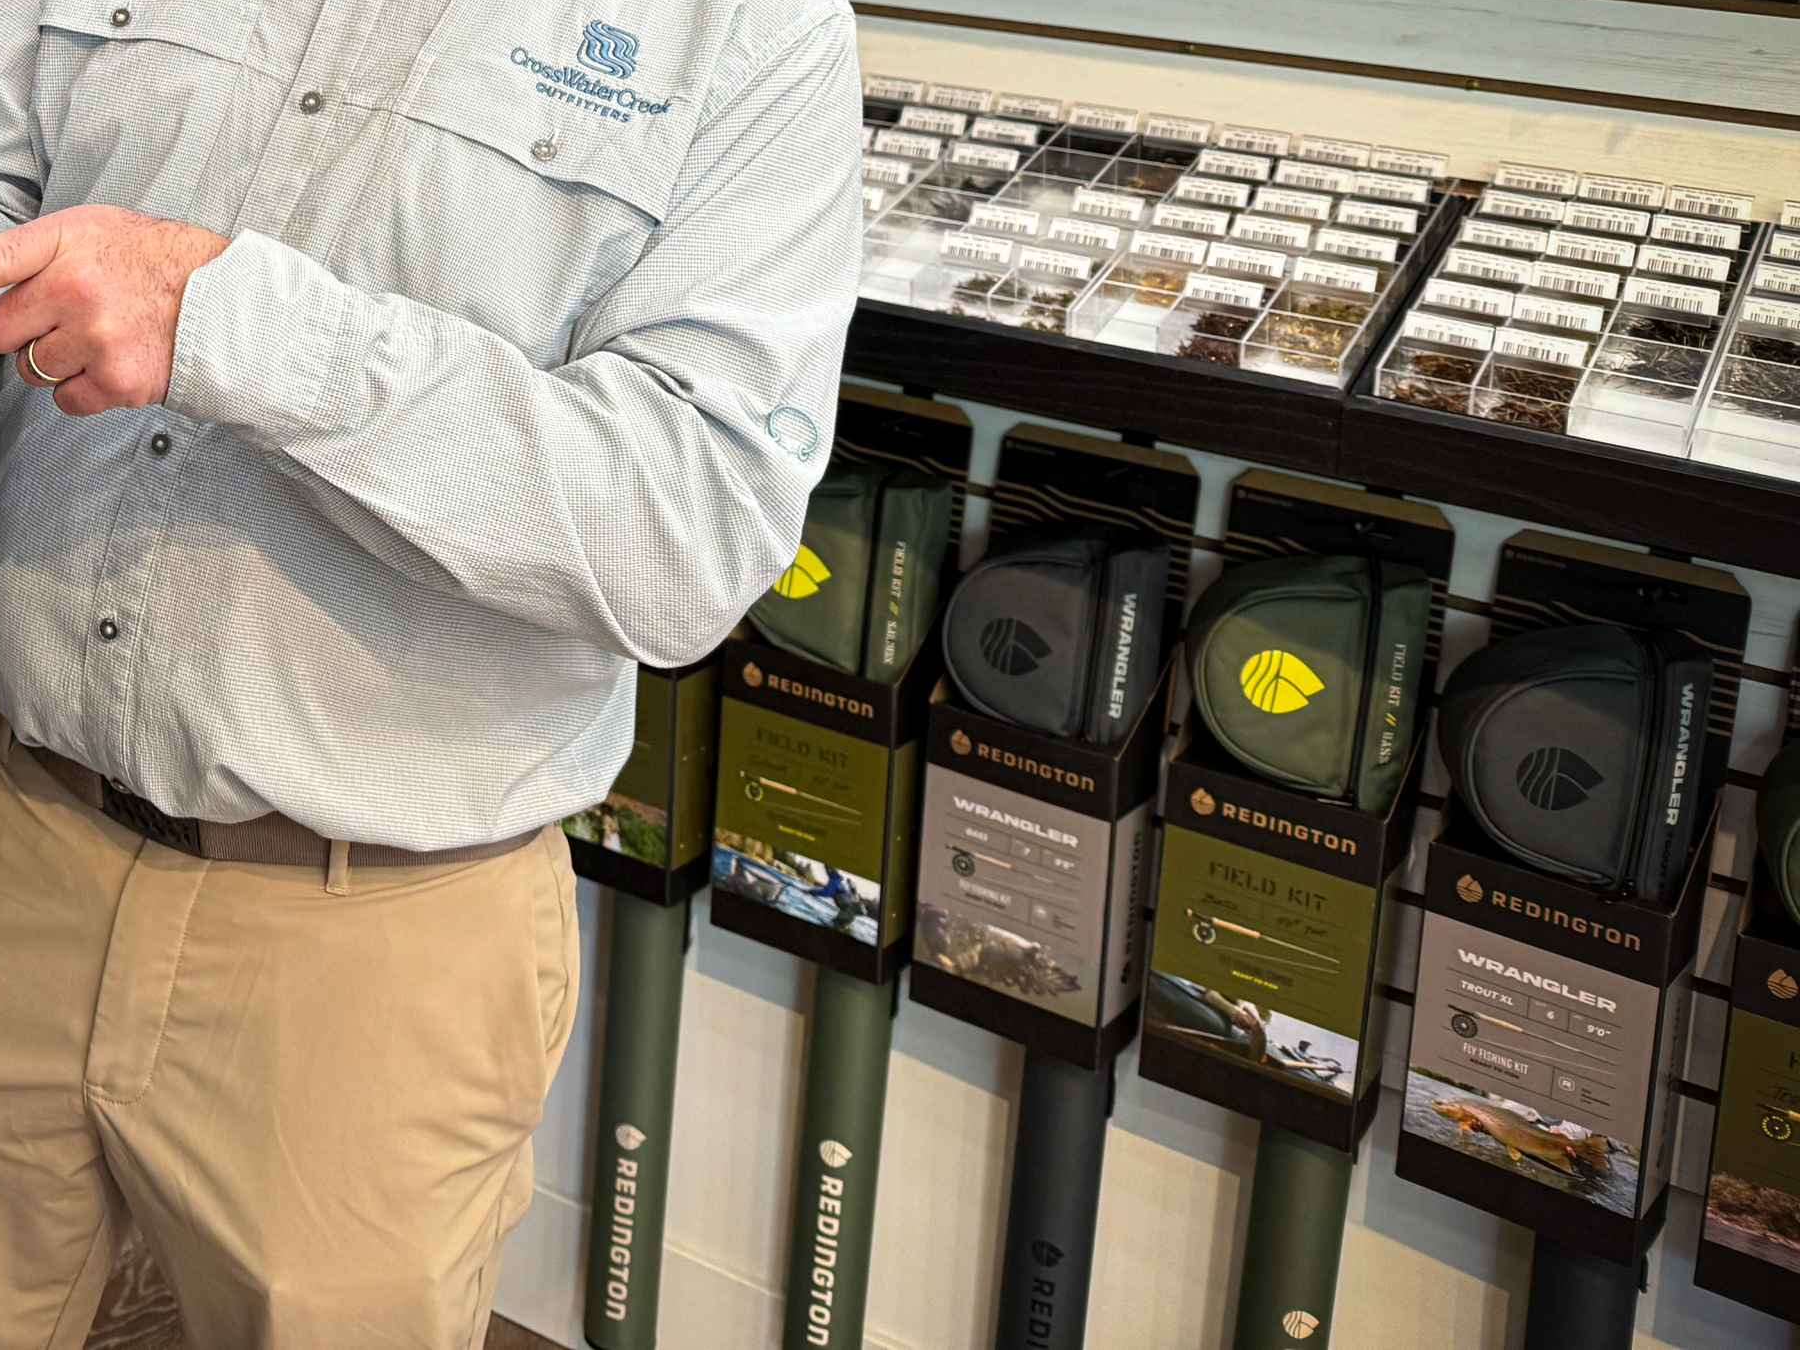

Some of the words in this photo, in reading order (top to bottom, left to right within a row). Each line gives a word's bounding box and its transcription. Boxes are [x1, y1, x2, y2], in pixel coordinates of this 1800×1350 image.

[510, 47, 674, 115] CrossWaterCreek
[535, 81, 632, 124] OUTFITTERS
[1108, 592, 1138, 721] WRANGLER
[1394, 642, 1407, 684] FIELD
[767, 674, 875, 719] REDINGTON
[1387, 685, 1401, 708] KIT
[756, 727, 811, 757] FIELD
[819, 746, 849, 769] KIT
[977, 742, 1096, 793] REDINGTON
[1665, 682, 1695, 827] WRANGLER
[952, 794, 1080, 849] WRANGLER
[1221, 802, 1358, 856] REDINGTON
[1208, 860, 1277, 897] FIELD
[1287, 886, 1330, 913] KIT
[1491, 889, 1642, 952] REDINGTON
[1456, 947, 1618, 1014] WRANGLER
[1460, 979, 1499, 1001] TROUT
[1499, 992, 1515, 1007] XL
[1546, 1009, 1555, 1021] 6
[1463, 1041, 1477, 1056] FLY
[1478, 1045, 1513, 1070] FISHING
[1514, 1061, 1530, 1076] KIT
[605, 1156, 638, 1322] REDINGTON
[807, 1173, 845, 1347] REDINGTON
